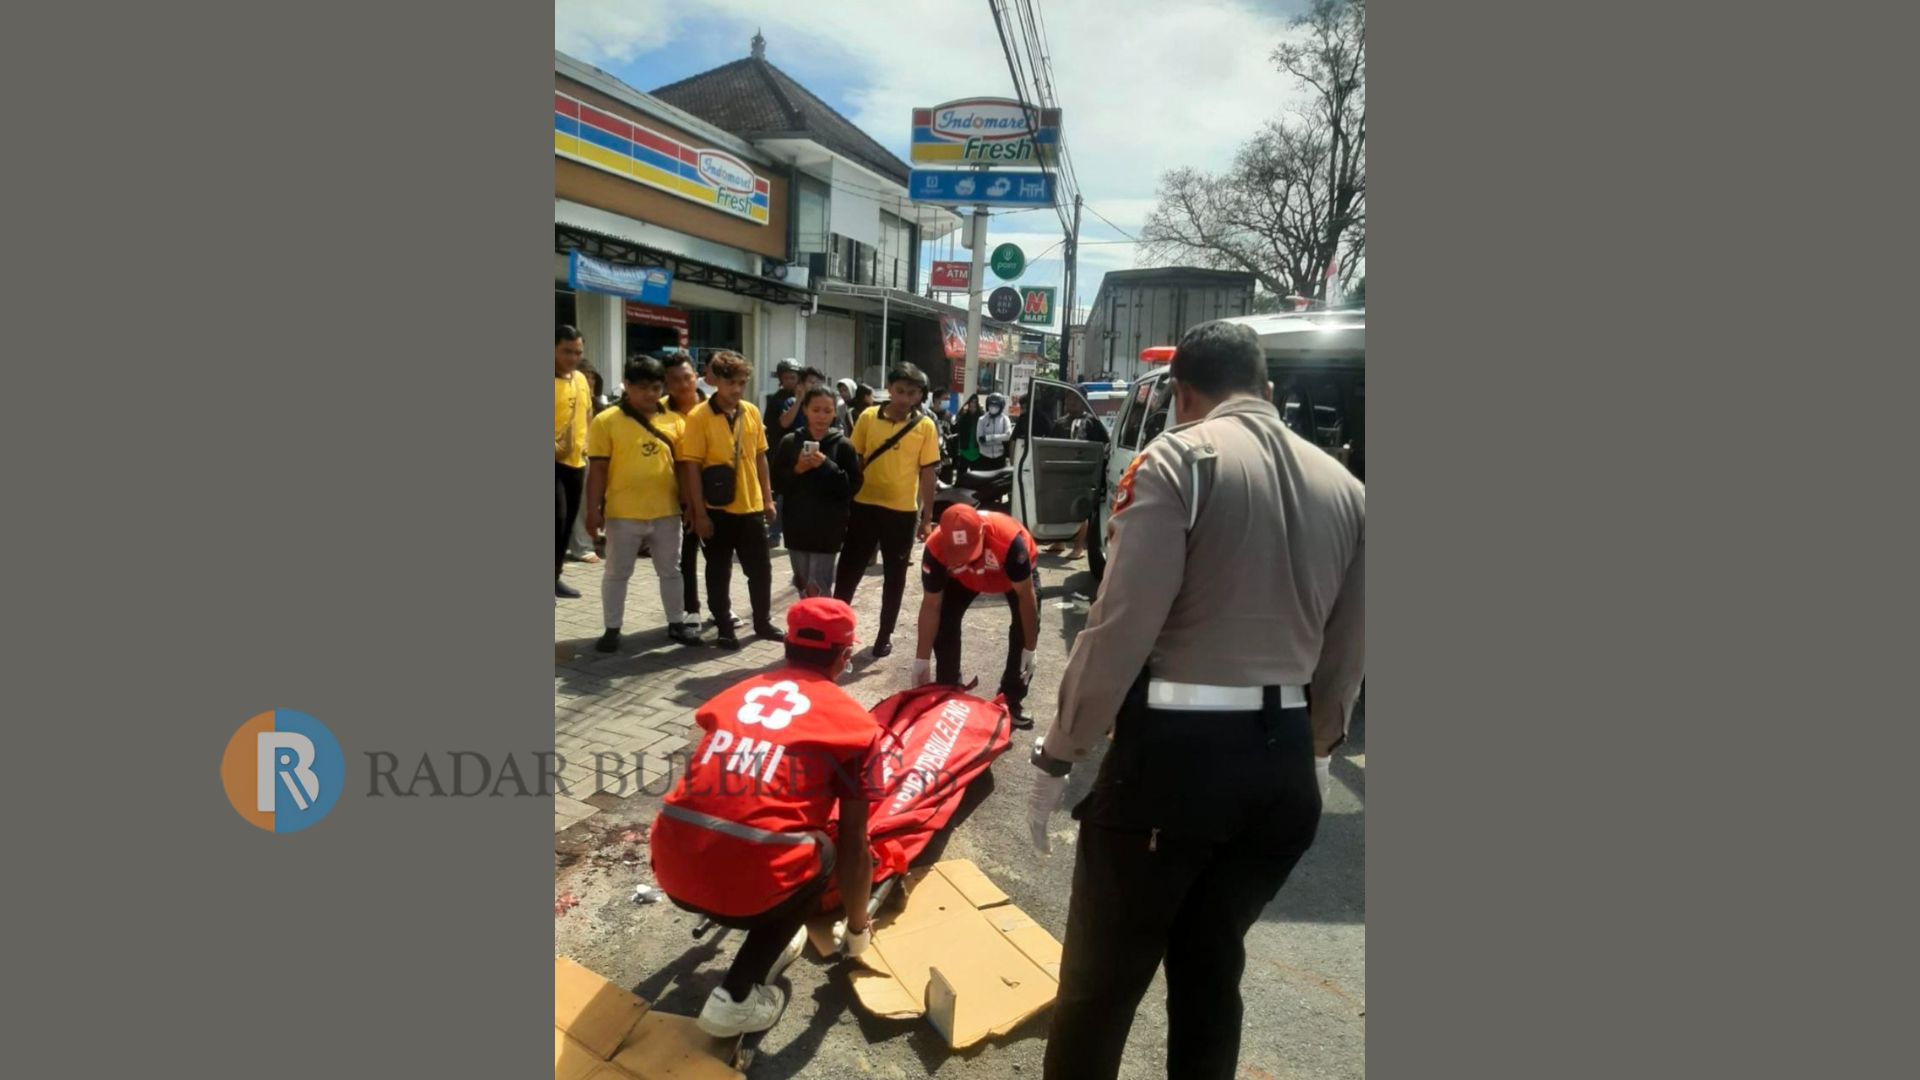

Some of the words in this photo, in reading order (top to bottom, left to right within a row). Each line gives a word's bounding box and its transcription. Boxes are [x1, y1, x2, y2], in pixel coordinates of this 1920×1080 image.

[964, 136, 1032, 160] Fresh
[702, 156, 752, 190] Indomaret
[716, 187, 752, 215] Fresh
[947, 269, 968, 279] ATM
[700, 729, 786, 784] PMI
